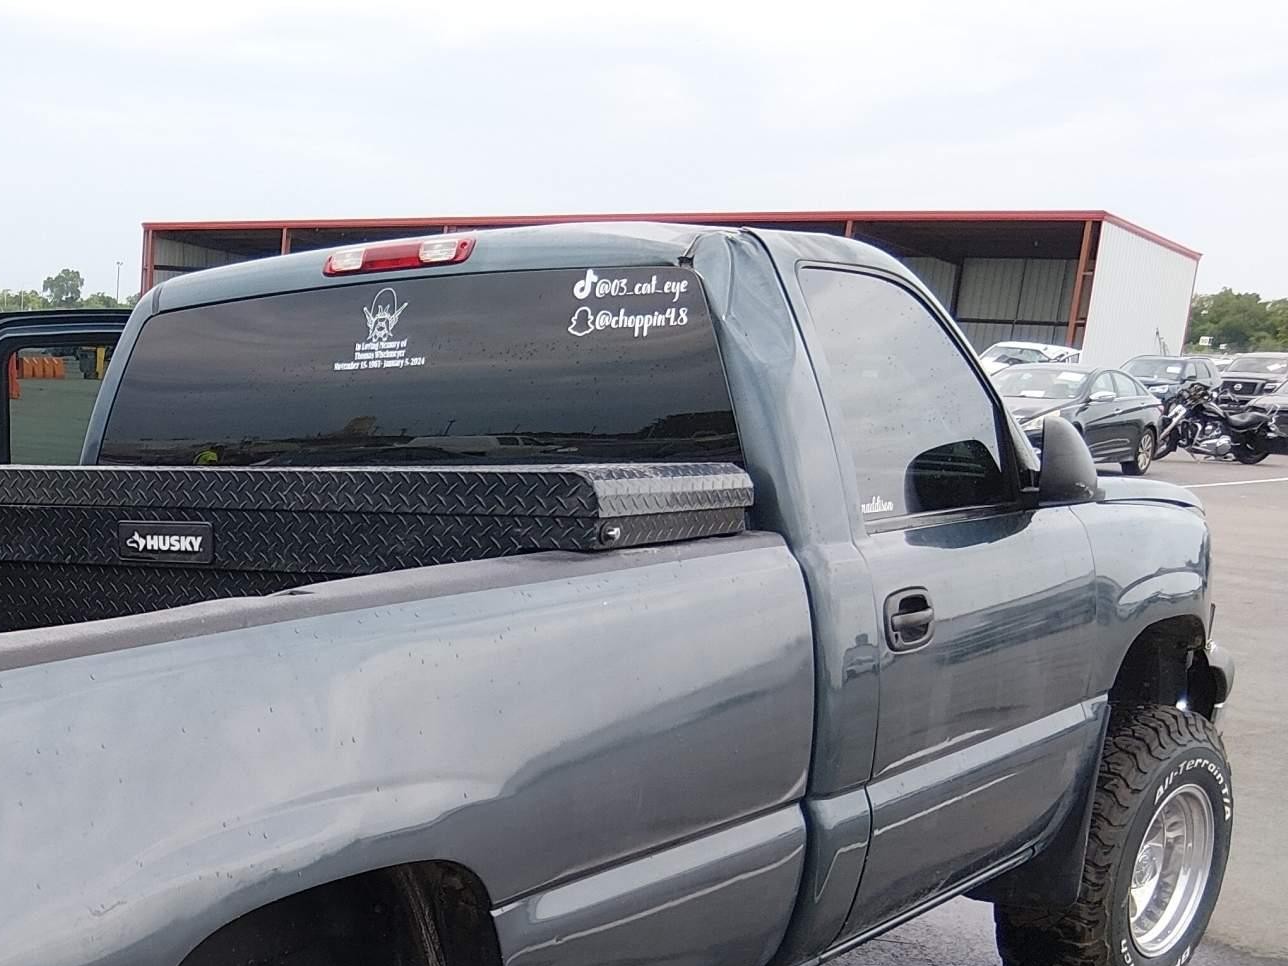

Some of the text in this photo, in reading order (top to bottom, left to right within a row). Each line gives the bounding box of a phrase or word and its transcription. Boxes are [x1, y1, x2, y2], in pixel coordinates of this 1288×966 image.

[595, 275, 689, 302] @03_cat_eye
[361, 342, 379, 351] Loving
[379, 340, 400, 350] Memory
[354, 351, 374, 360] Thomas
[334, 362, 360, 370] November
[146, 534, 202, 552] HUSKY
[1154, 758, 1231, 821] All-Terrain T/A
